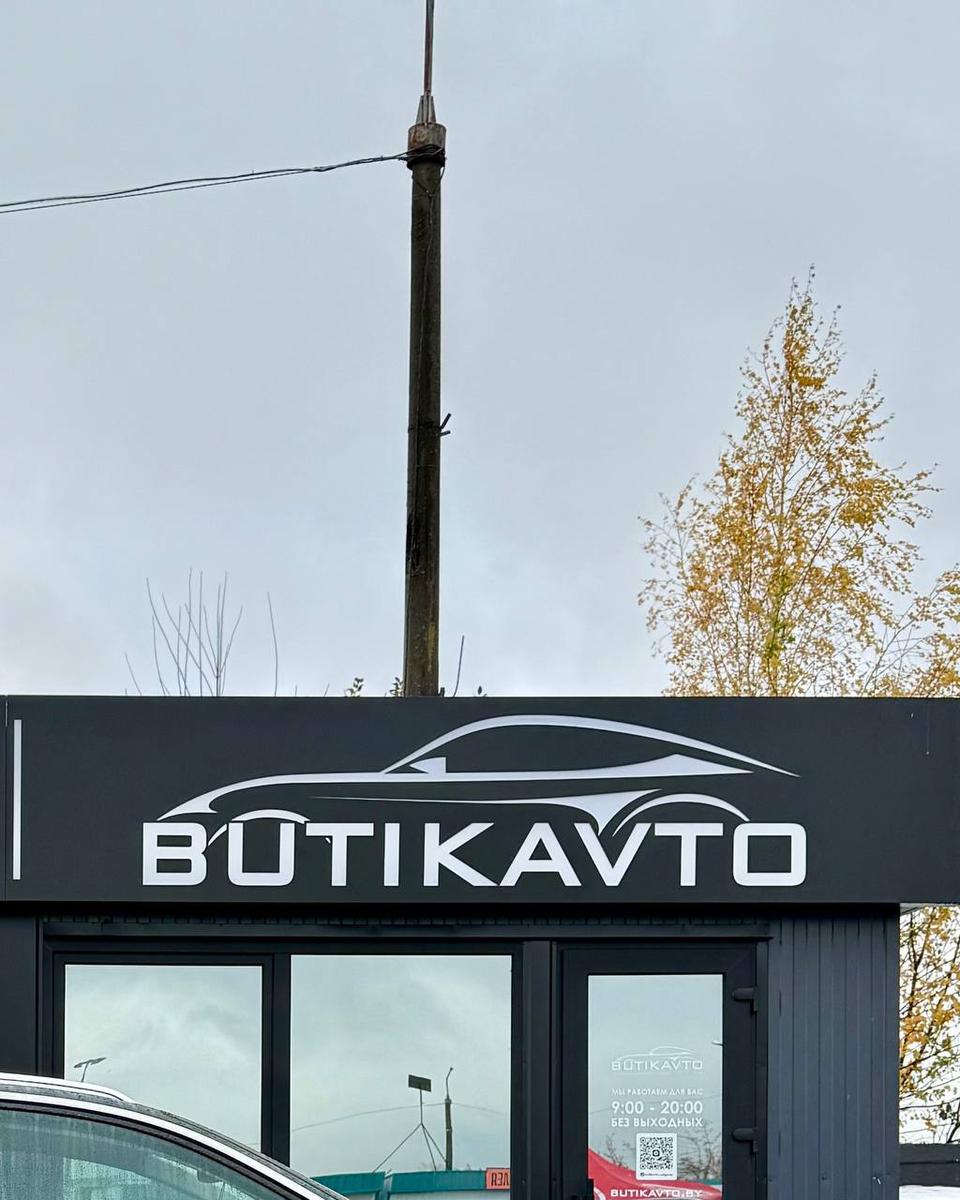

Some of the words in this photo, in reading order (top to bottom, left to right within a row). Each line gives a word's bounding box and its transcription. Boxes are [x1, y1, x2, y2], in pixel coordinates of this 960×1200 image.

[142, 822, 807, 887] BUTIKAVTO
[611, 1060, 703, 1071] BUTIKAVTO
[611, 1088, 625, 1096] МЫ
[627, 1088, 667, 1096] РАБОТАЕМ
[669, 1088, 685, 1096] ДЛЯ
[687, 1088, 703, 1096] ВАС
[611, 1100, 644, 1114] 9:00
[660, 1100, 703, 1114] 20:00
[611, 1117, 630, 1127] БЕЗ
[633, 1117, 703, 1128] ВЫХОДНЫХ
[610, 1189, 703, 1198] BUTIKAVTO.BY
